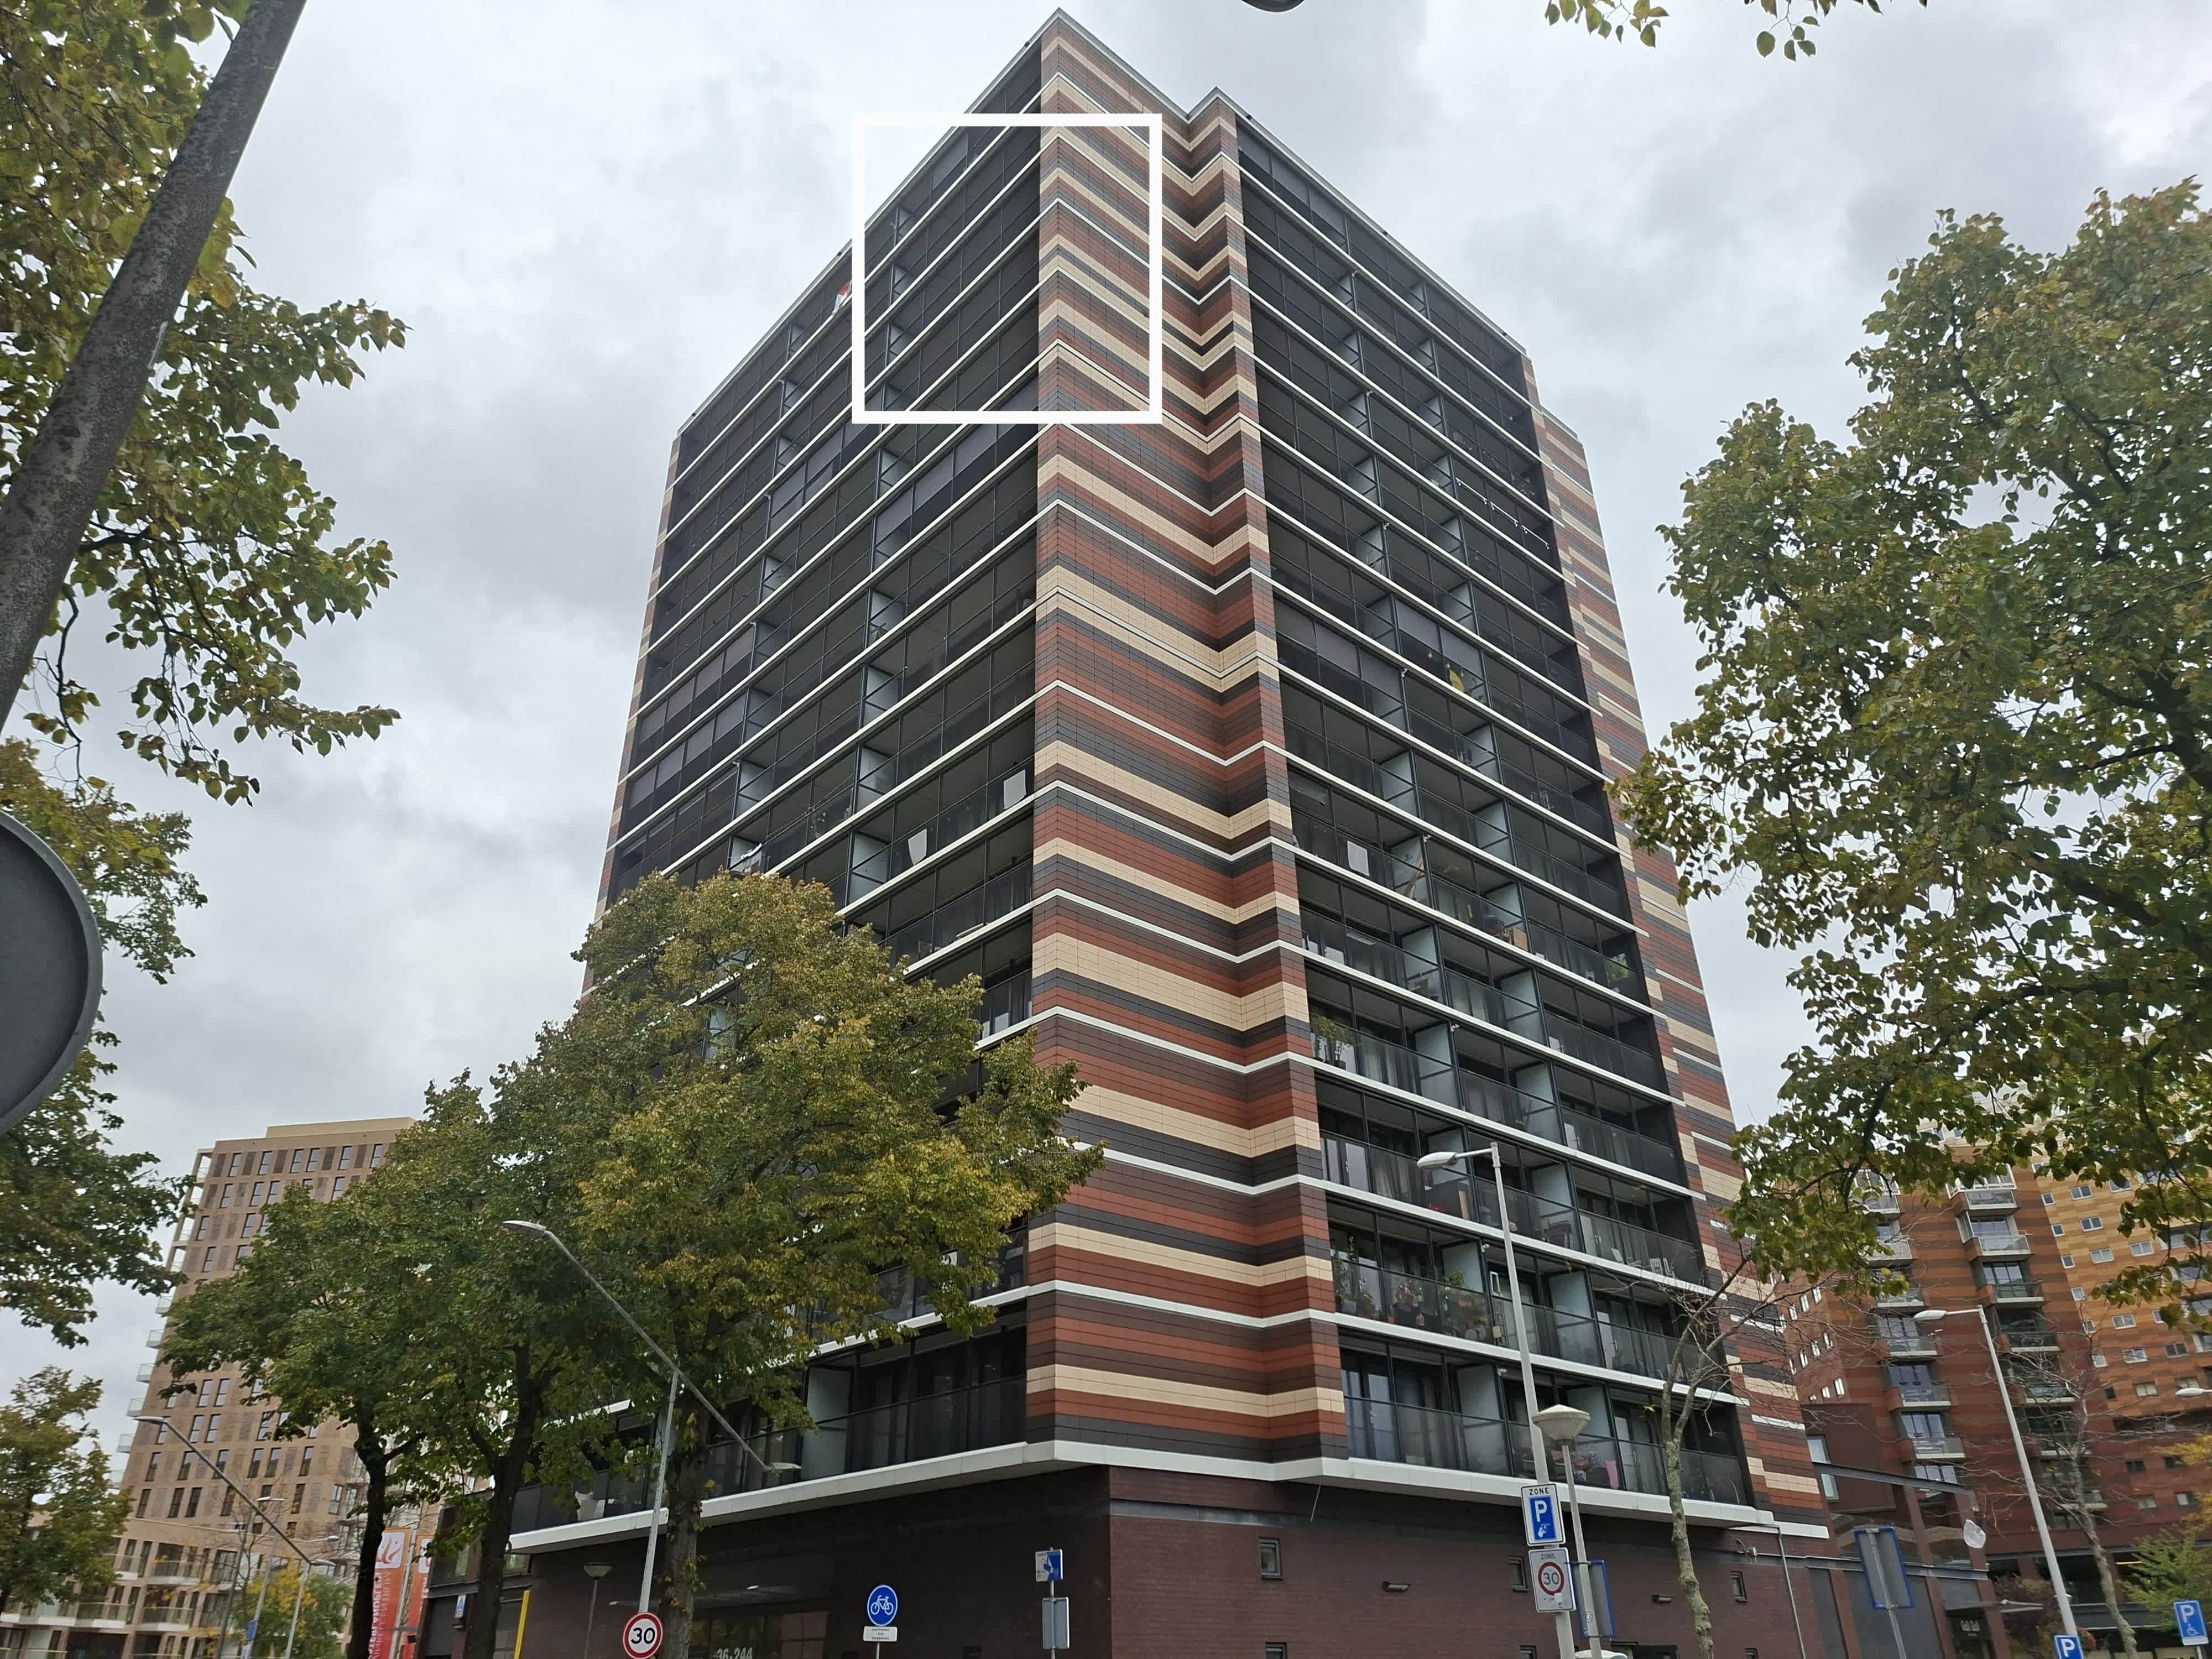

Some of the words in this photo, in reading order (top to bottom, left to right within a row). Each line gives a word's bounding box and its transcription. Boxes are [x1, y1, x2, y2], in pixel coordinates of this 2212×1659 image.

[1529, 1487, 1550, 1496] ZONE
[1535, 1500, 1547, 1522] P
[1543, 1572, 1559, 1585] 30
[2180, 1605, 2194, 1623] P
[631, 1627, 655, 1645] 30
[2060, 1639, 2075, 1658] P
